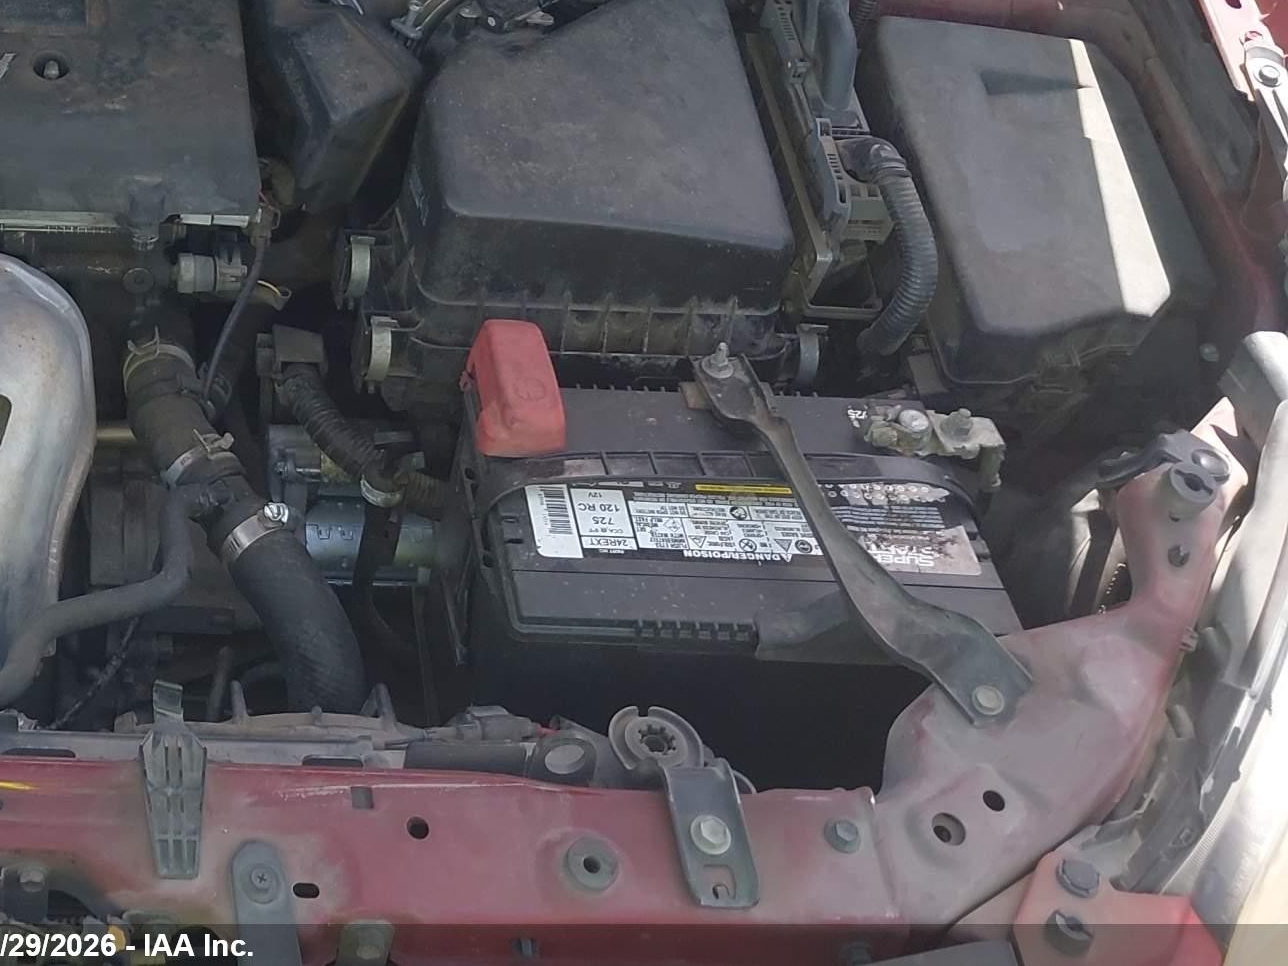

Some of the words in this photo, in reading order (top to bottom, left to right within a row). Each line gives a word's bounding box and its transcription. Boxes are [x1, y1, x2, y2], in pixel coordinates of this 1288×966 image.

[578, 503, 595, 511] RC
[600, 504, 620, 512] 120
[592, 516, 614, 525] 725
[589, 538, 628, 546] 24REXT
[683, 550, 781, 561] DANGER/POISON
[873, 554, 934, 566] SUPER
